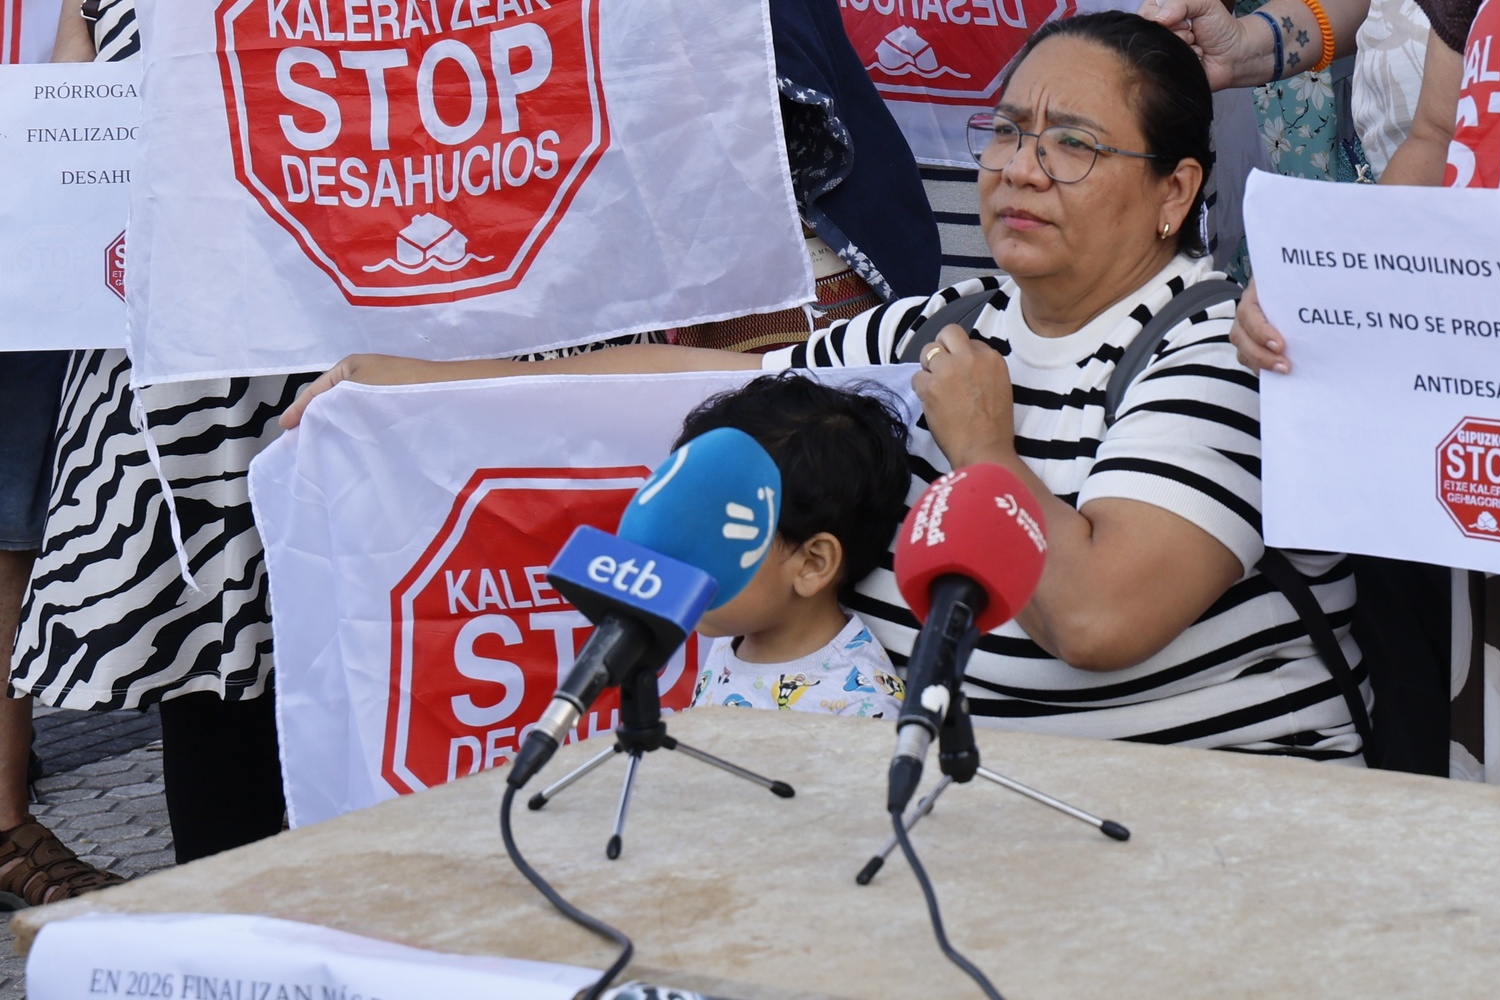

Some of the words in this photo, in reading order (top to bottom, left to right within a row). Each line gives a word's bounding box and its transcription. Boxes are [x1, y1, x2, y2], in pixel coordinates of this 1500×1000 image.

[34, 82, 138, 99] PRÓRROGA
[275, 22, 553, 151] STOP
[281, 130, 561, 208] DESAHUCIOS
[1281, 246, 1337, 268] MILES
[1342, 251, 1368, 269] DE
[1374, 253, 1492, 278] INQUILINOS
[1298, 307, 1362, 330] CALLE,
[1366, 310, 1383, 328] SI
[1389, 313, 1419, 331] NO
[1425, 315, 1446, 334] SE
[1443, 479, 1469, 493] ETXE
[587, 554, 663, 600] etb
[89, 967, 122, 994] EN
[126, 970, 175, 998] 2026
